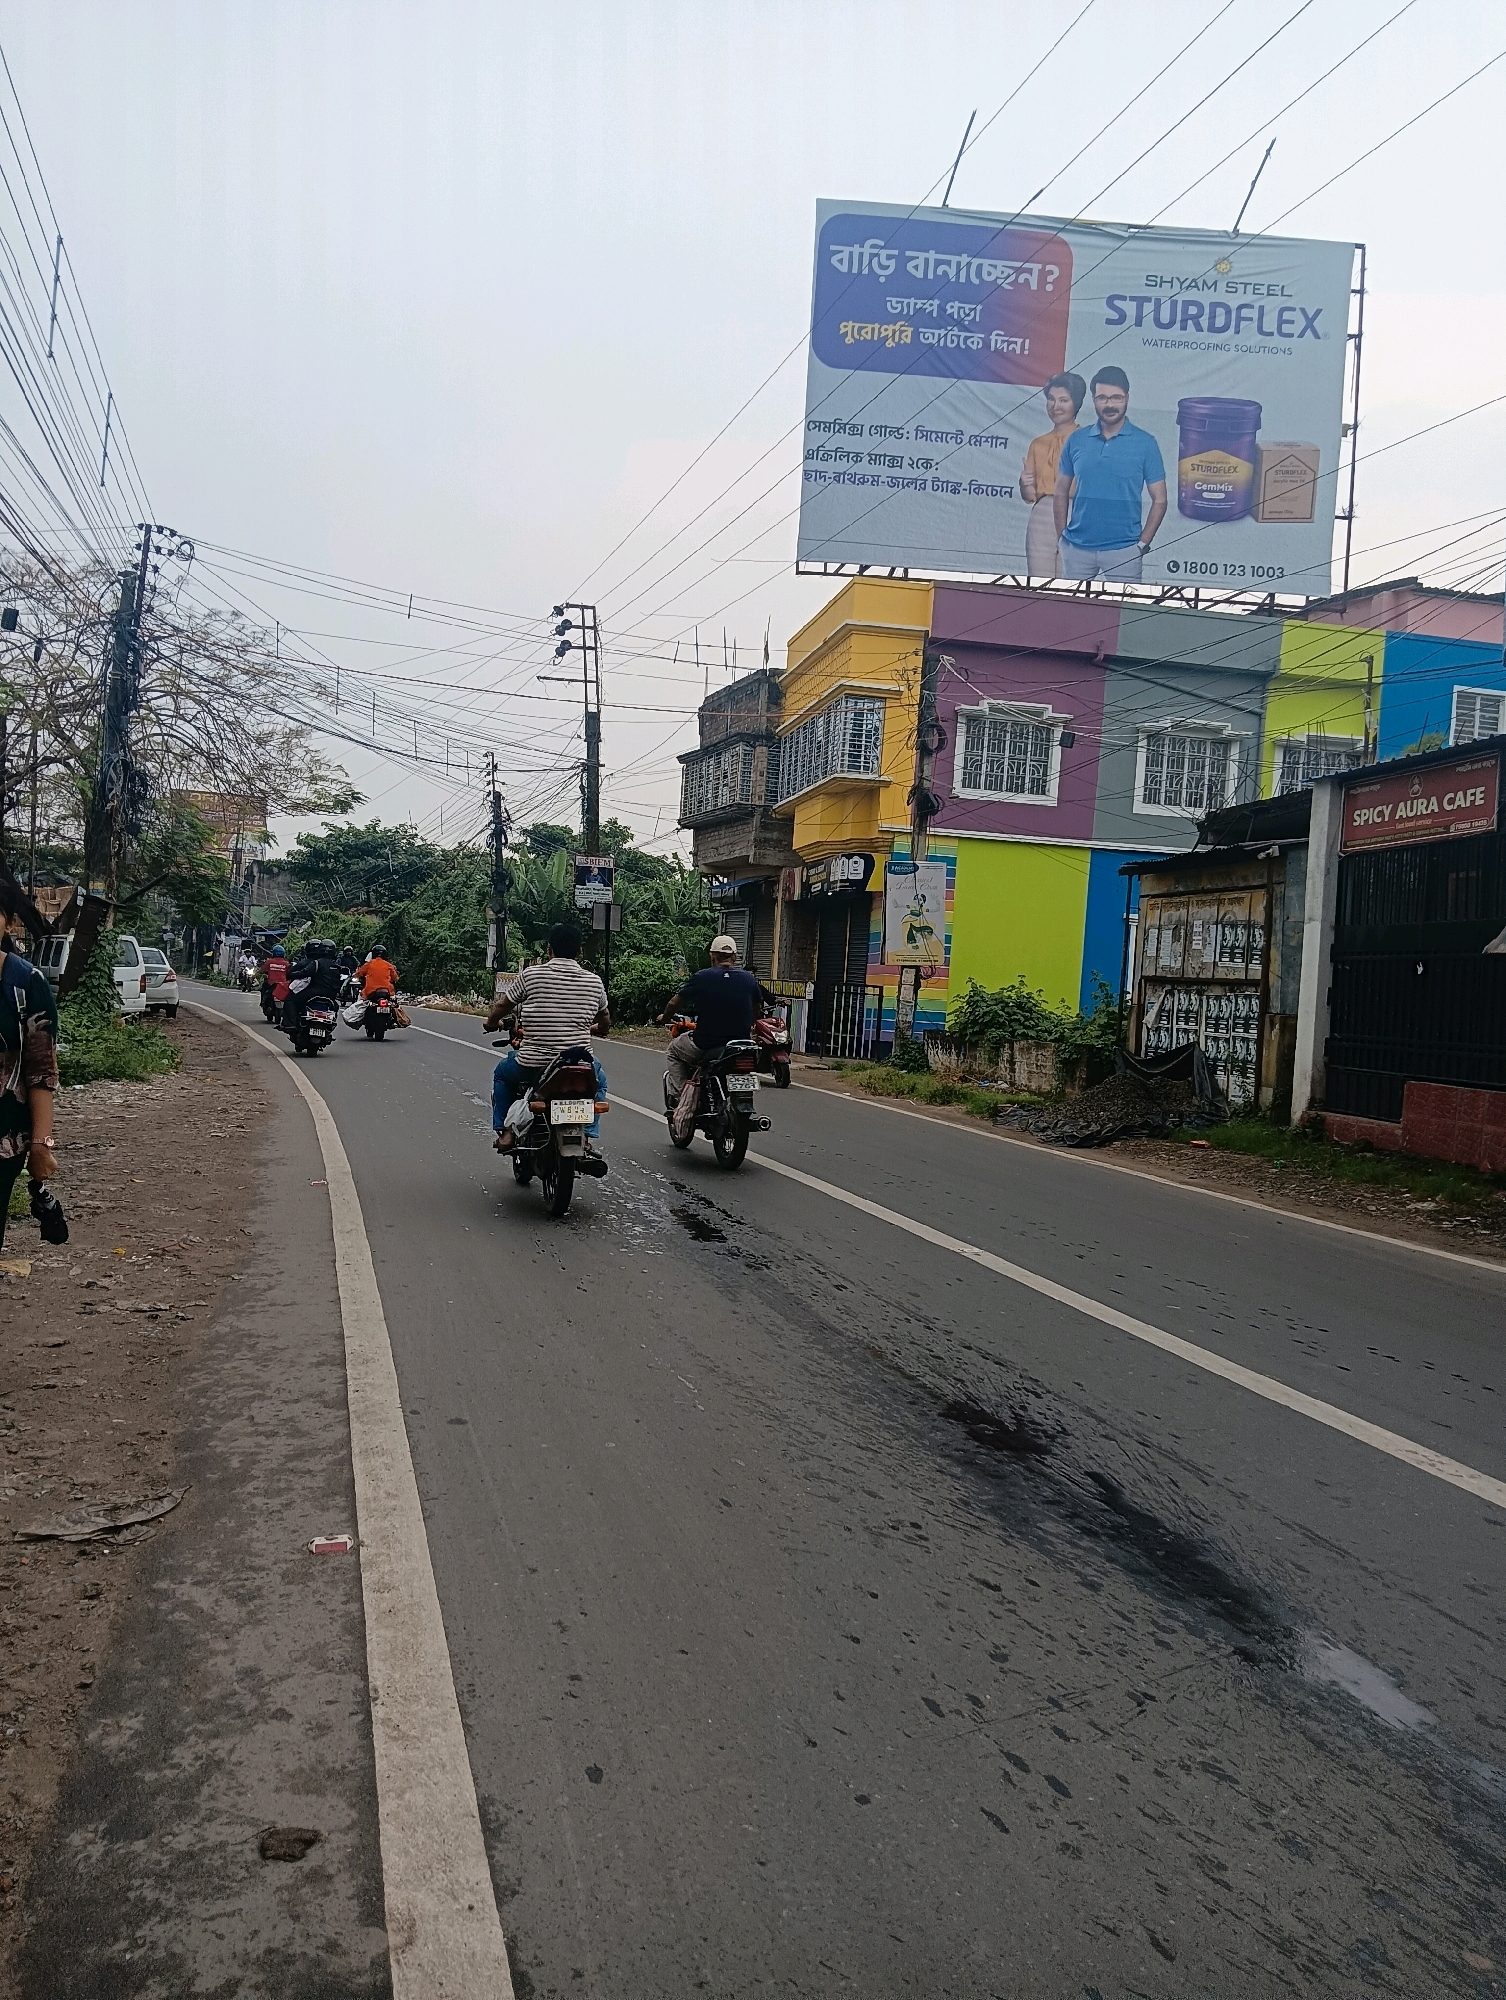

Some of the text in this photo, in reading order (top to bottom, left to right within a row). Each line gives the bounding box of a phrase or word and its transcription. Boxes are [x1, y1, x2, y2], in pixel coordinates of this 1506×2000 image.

[829, 238, 899, 283] বাড়ি
[1145, 274, 1293, 298] SHYAM STEEL
[945, 299, 983, 325] পড়া
[1105, 293, 1323, 340] STURDFLEX
[839, 320, 914, 348] পুরোপুরি
[919, 326, 985, 350] আটকে
[1142, 337, 1293, 356] WATERPROOFING SOLUTIONS
[1190, 463, 1238, 474] STURDFLEX
[1194, 481, 1233, 492] CemMix
[1183, 561, 1285, 579] 1800 123 1003
[1353, 786, 1486, 827] SPICY AURA CAFE
